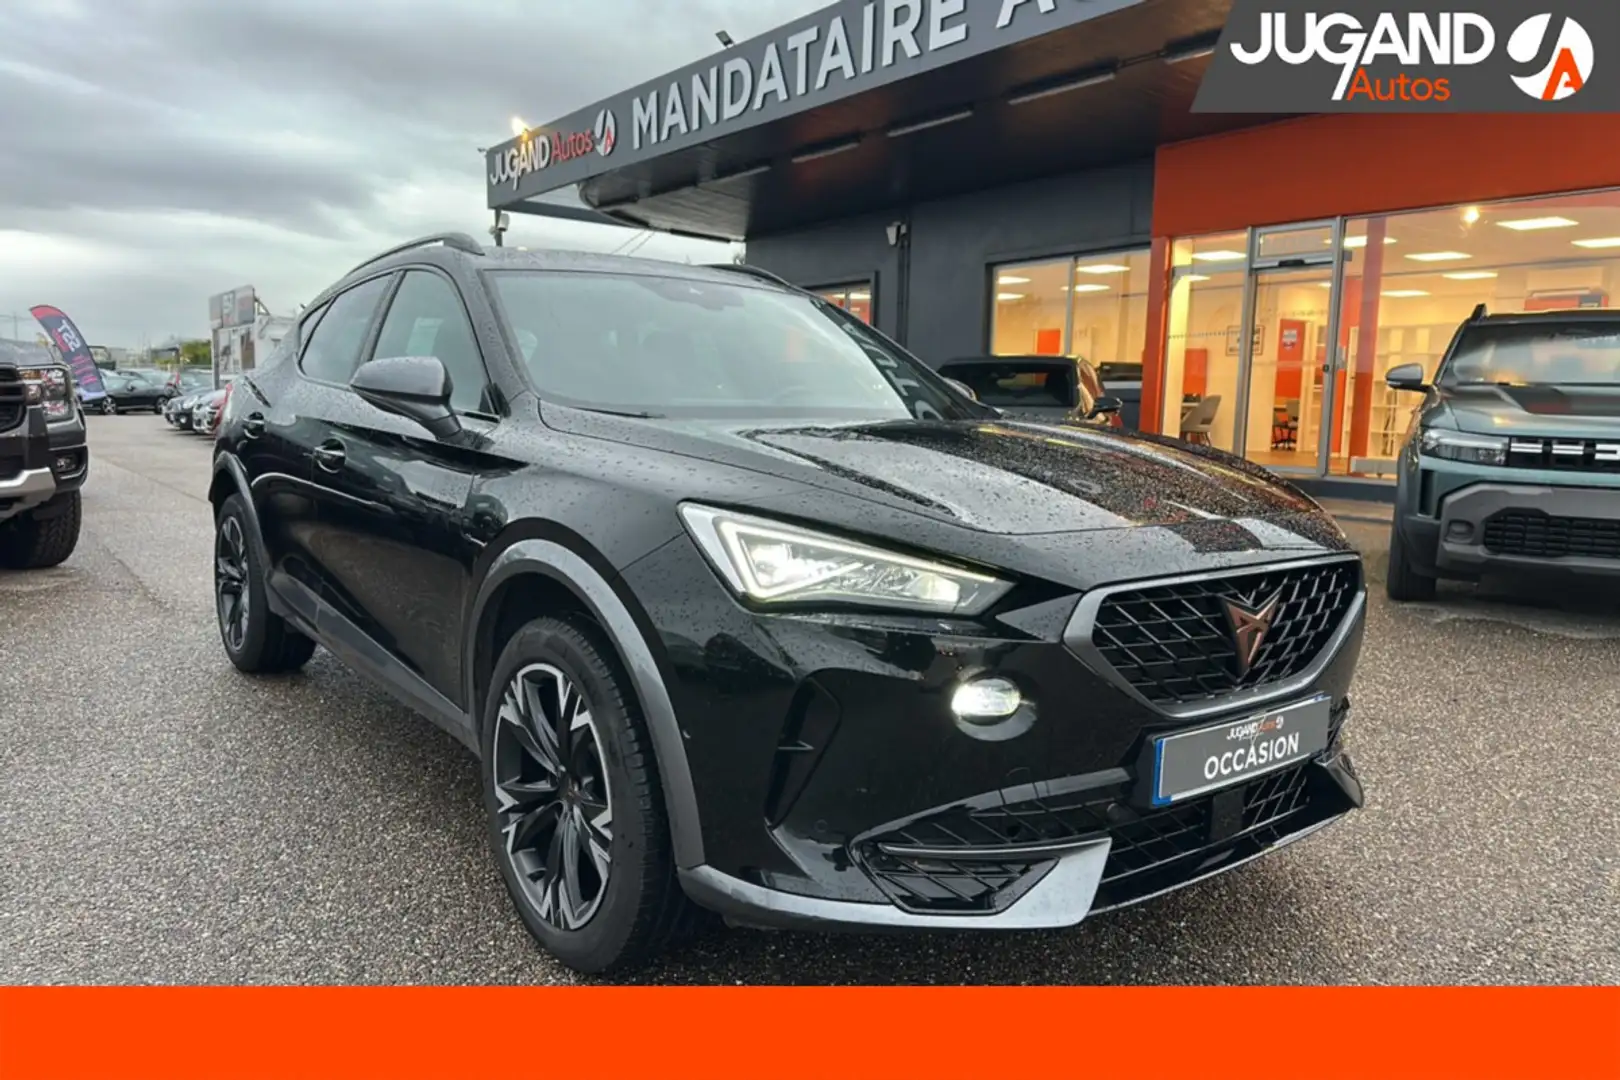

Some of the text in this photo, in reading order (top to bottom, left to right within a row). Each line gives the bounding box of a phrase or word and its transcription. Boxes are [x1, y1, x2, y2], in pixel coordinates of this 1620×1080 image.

[632, 0, 967, 149] MANDATAIRE
[490, 128, 593, 191] JUGAND Autos
[1203, 732, 1300, 780] OCCASION
